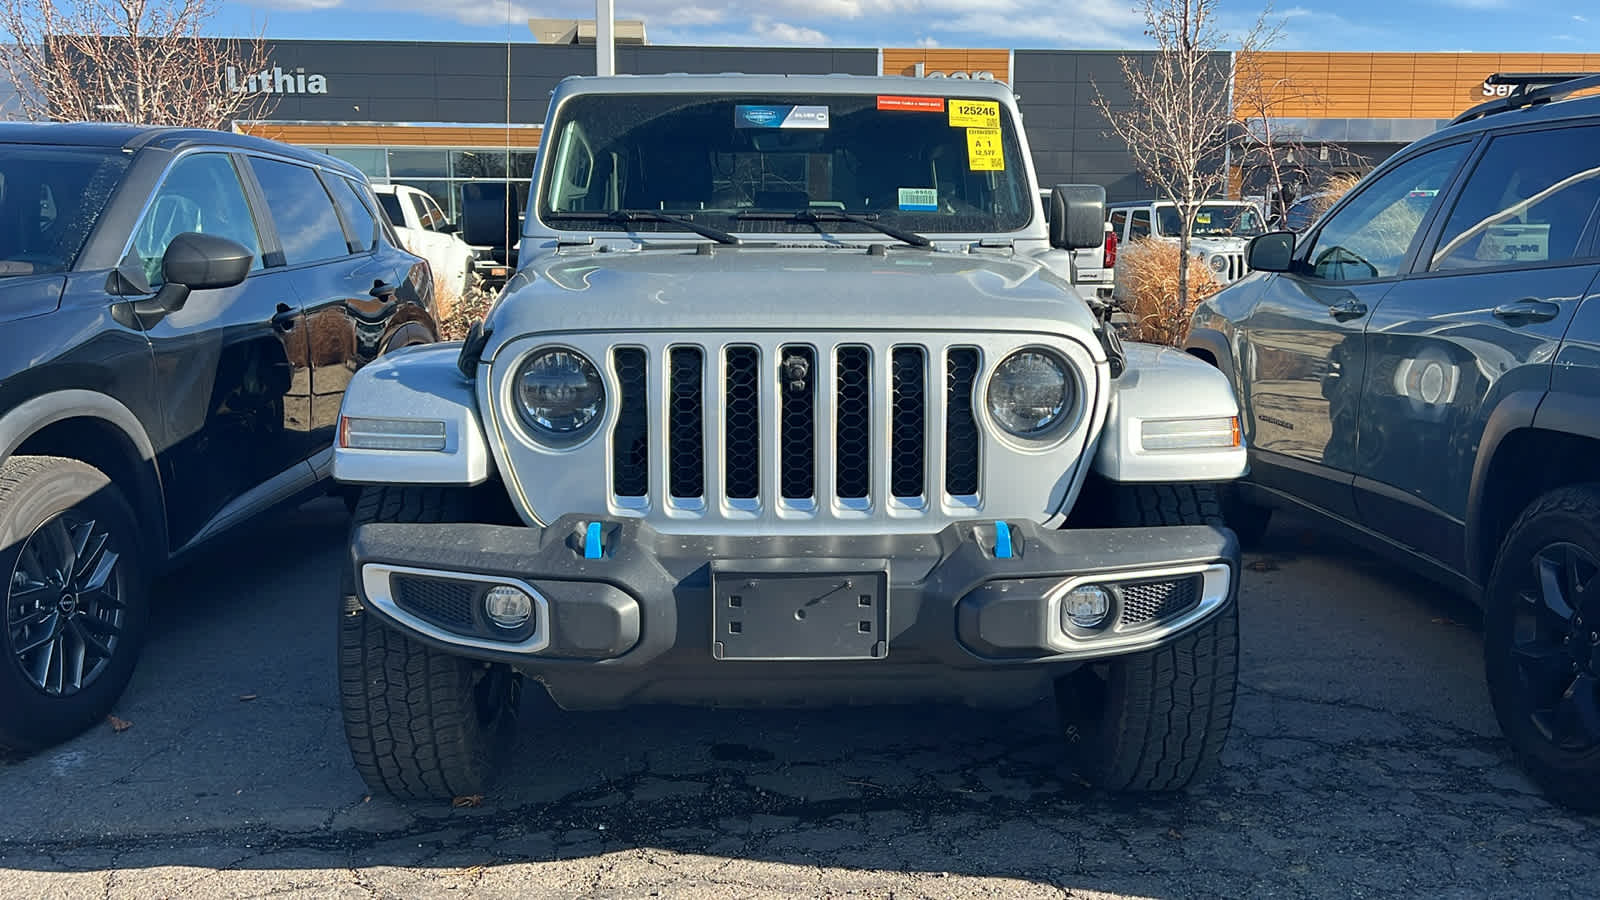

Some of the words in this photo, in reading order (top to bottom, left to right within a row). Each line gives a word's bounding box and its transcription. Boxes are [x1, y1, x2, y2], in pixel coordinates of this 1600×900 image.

[227, 66, 328, 94] Lithia
[958, 106, 996, 116] 125246
[975, 140, 982, 148] A
[986, 140, 992, 148] 1
